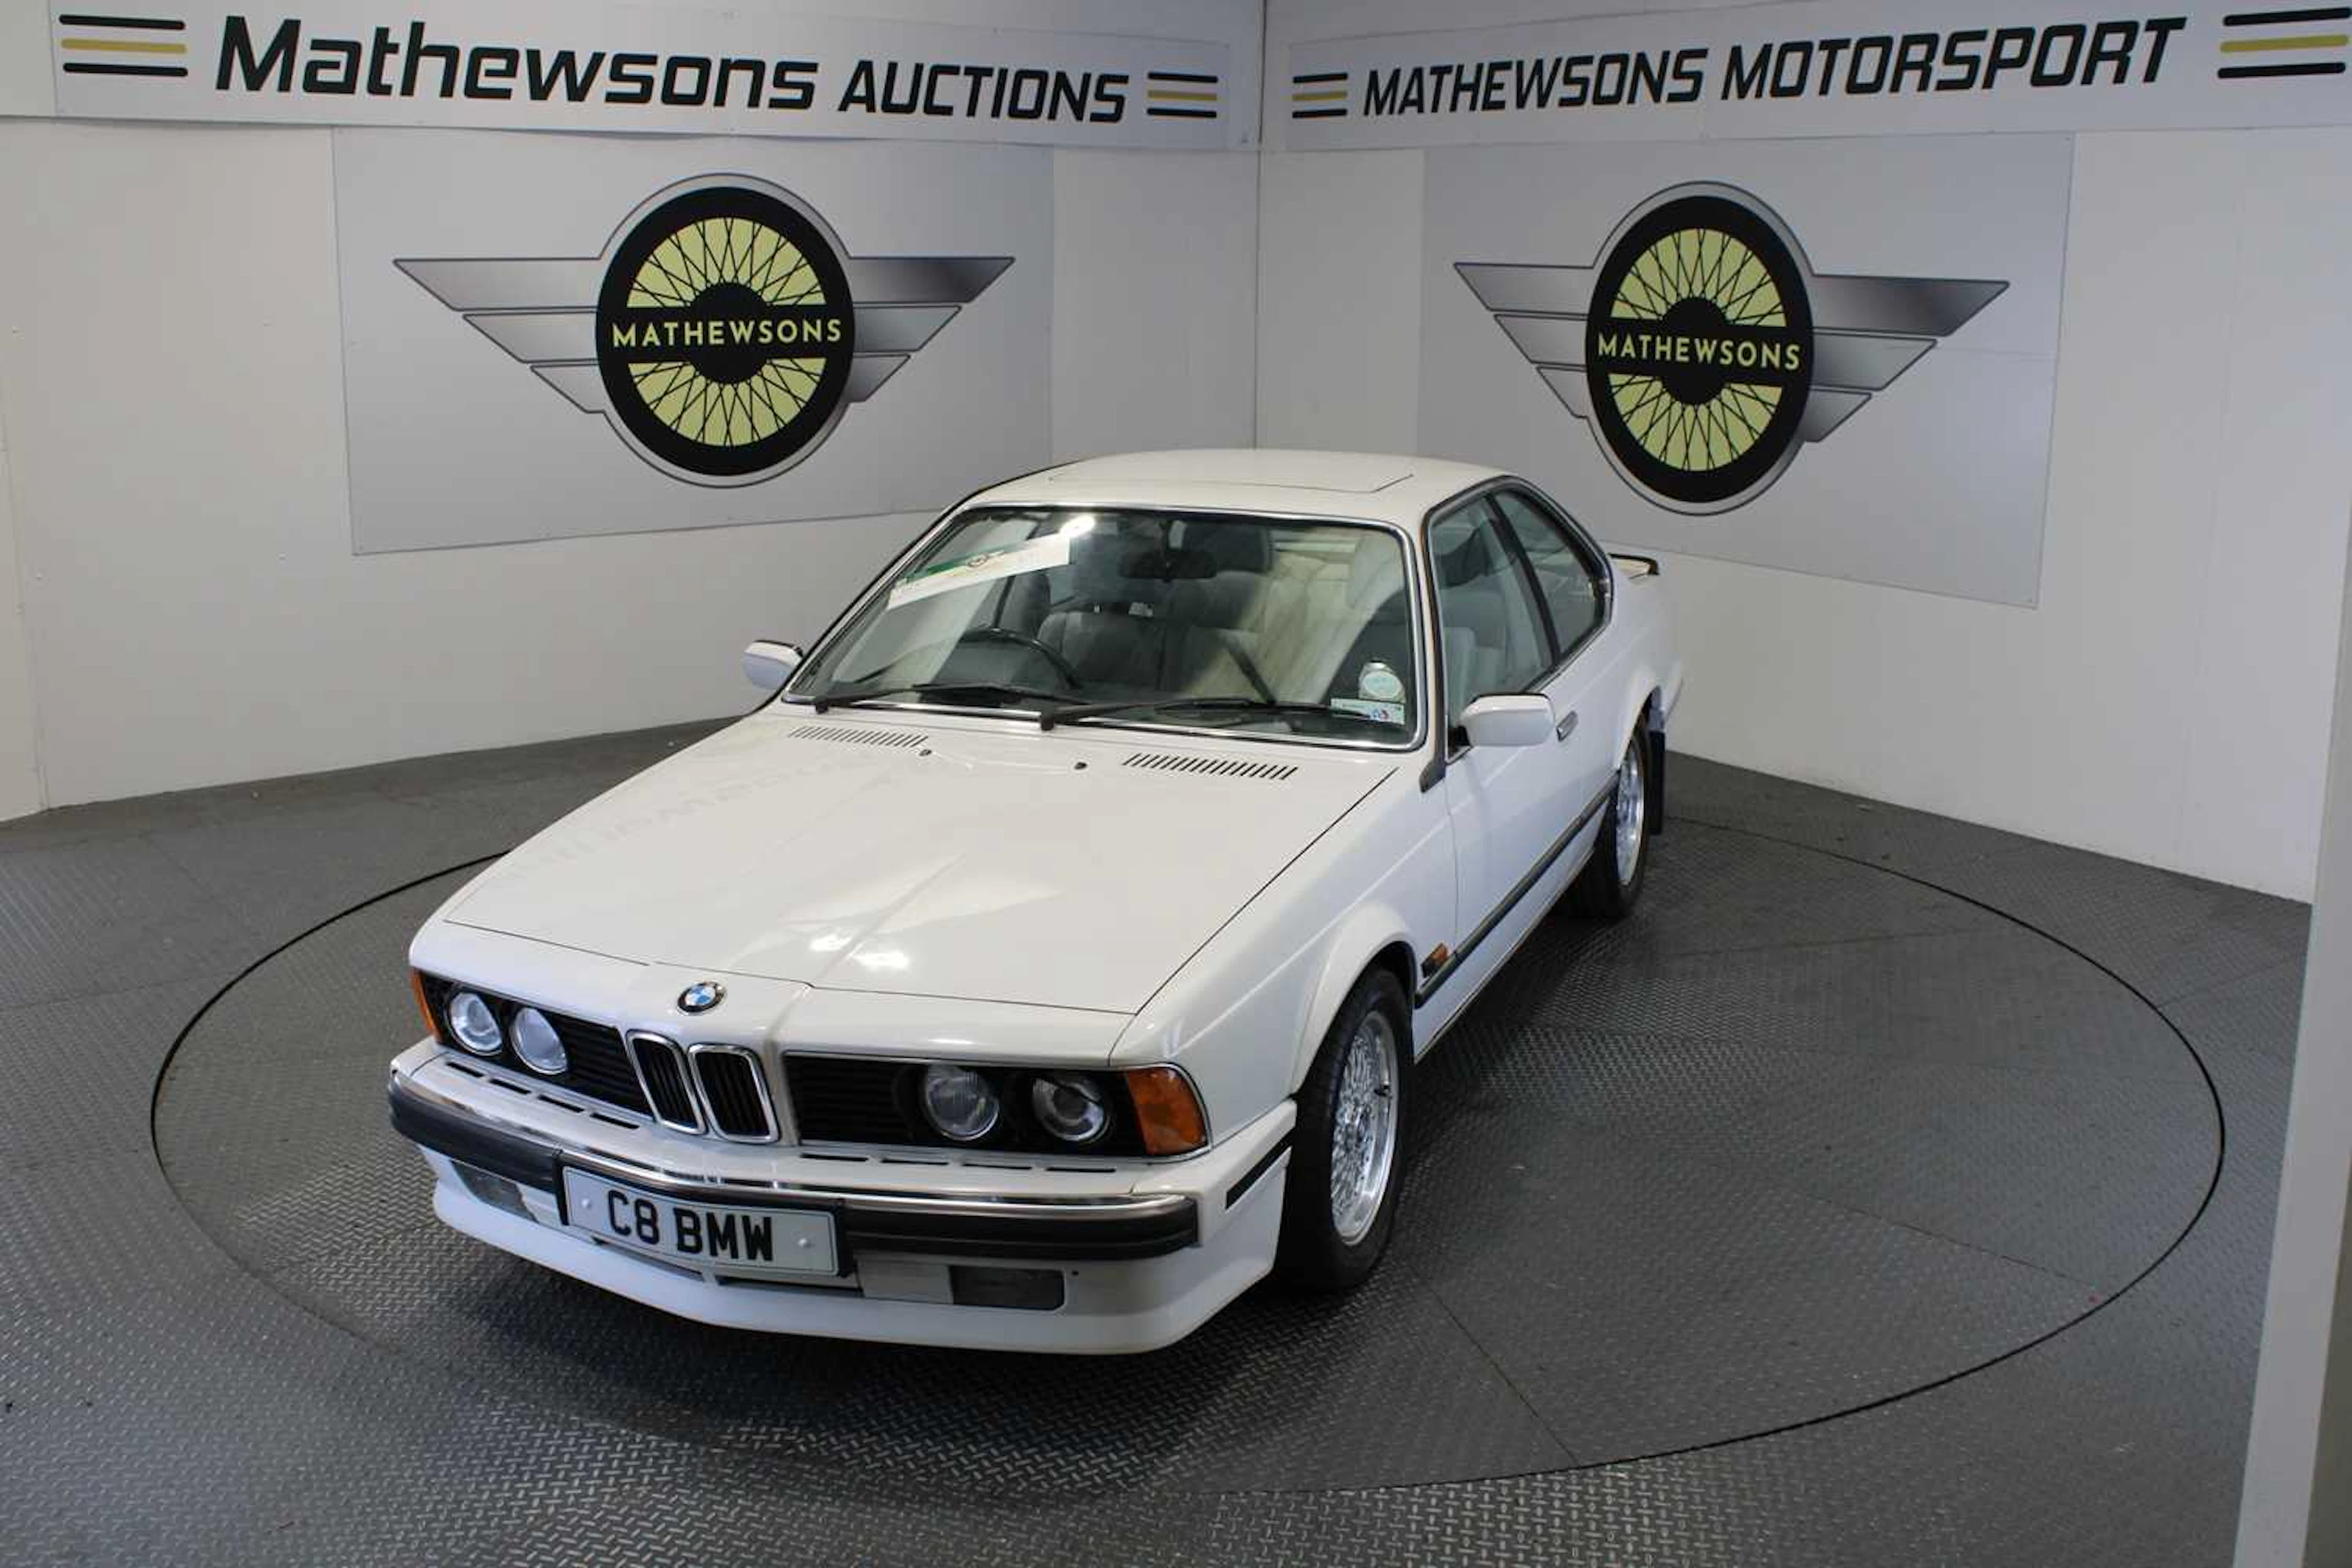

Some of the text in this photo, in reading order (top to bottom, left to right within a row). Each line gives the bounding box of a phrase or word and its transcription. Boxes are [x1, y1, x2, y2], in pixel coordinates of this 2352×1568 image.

[216, 15, 1129, 124] Mathewsons AUCTIONS
[1363, 17, 2187, 117] MATHEWSONS MOTORSPORT
[612, 318, 842, 347] MATHEWSONS
[1599, 333, 1800, 370] MATHEWSONS
[608, 1189, 774, 1262] C8 BMW
